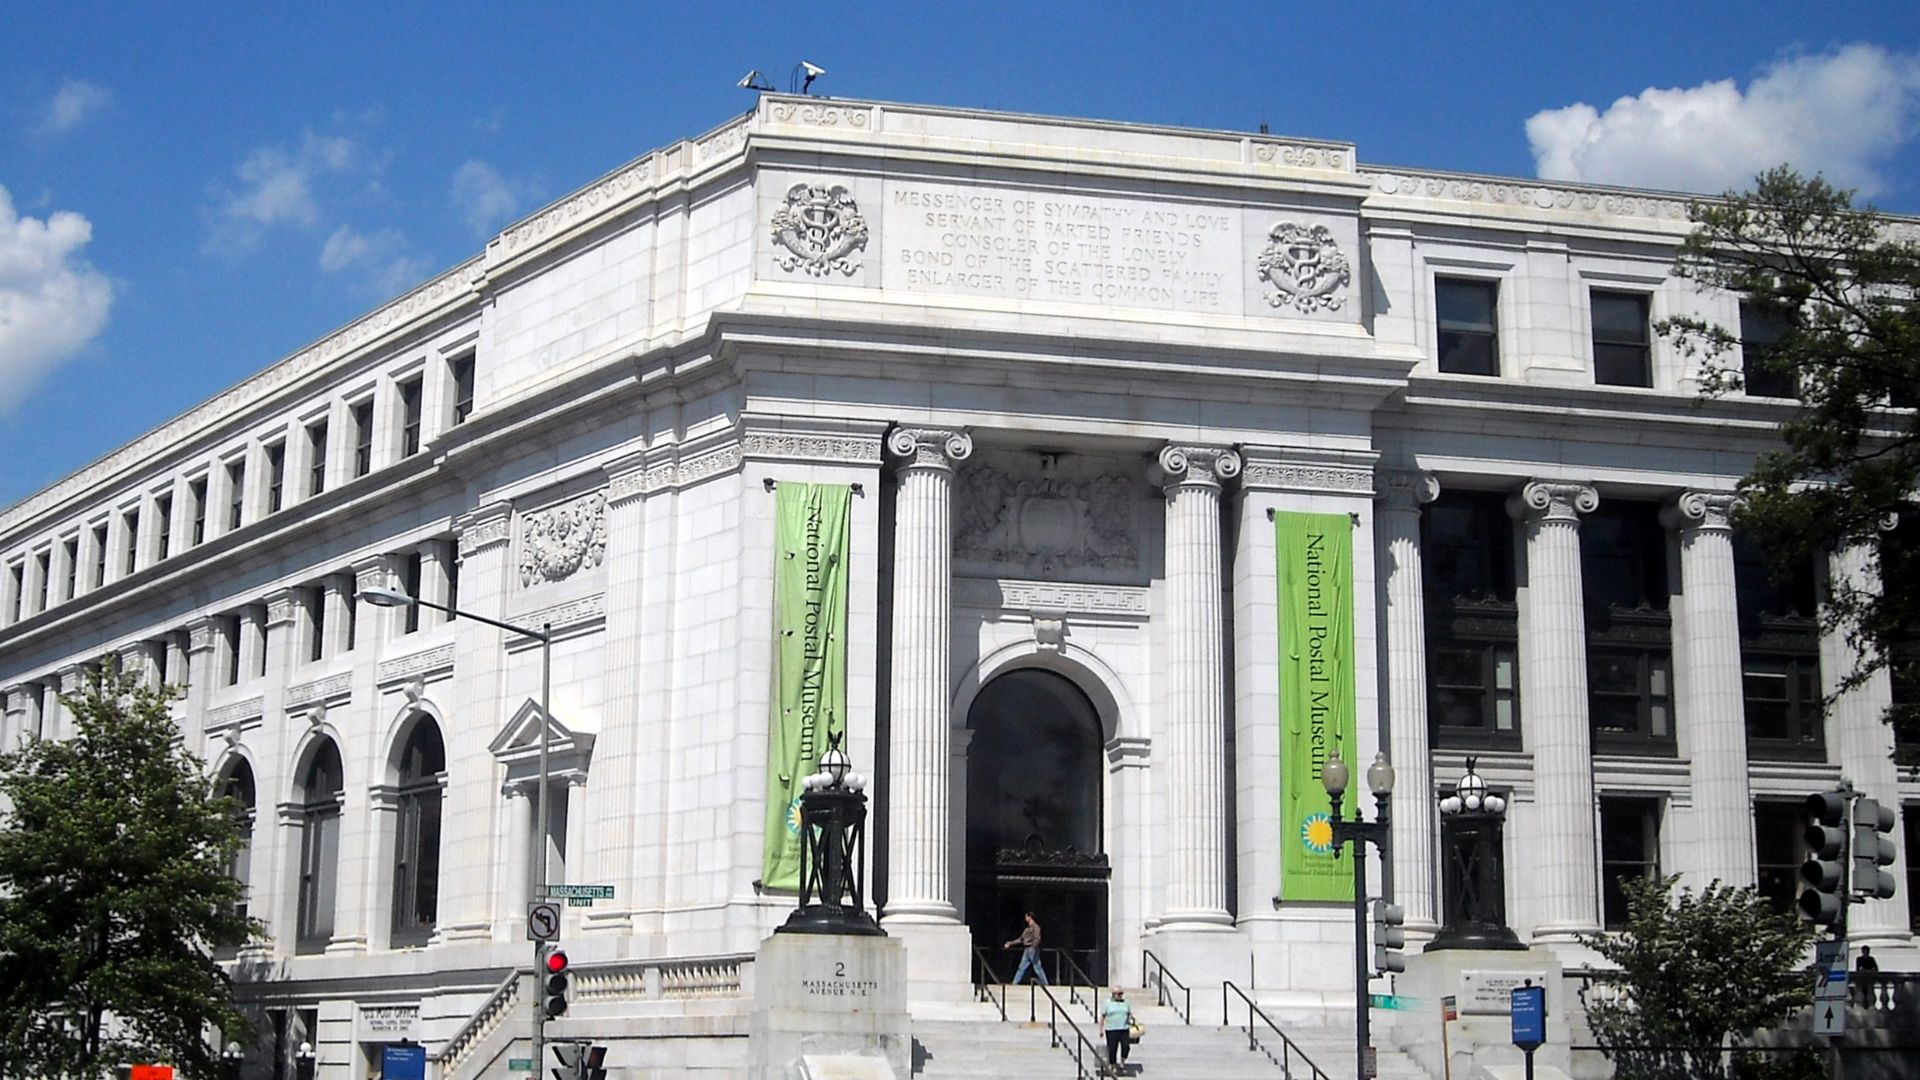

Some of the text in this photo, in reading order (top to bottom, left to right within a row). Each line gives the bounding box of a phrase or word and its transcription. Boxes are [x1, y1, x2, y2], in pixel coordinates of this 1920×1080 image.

[894, 190, 1230, 231] MESSENGER OF SYMPATHY AND LOVE
[925, 212, 1202, 248] SERVANT OF PARTED FRIENDS
[941, 233, 1187, 265] CONSOLER OF THE LONELY
[901, 249, 1224, 288] BOND OF THE SCATTERED FAMILY
[907, 268, 1219, 306] ENLARGER OF THE COMMON LIFE
[800, 506, 825, 761] National Postal Museum
[1306, 533, 1330, 781] National Postal Museum
[550, 886, 604, 897] MASSACHUSETTS
[569, 898, 592, 907] UNIT
[802, 980, 878, 990] MASSACHUSETTS
[835, 961, 845, 977] 2
[809, 988, 845, 996] AVENUE
